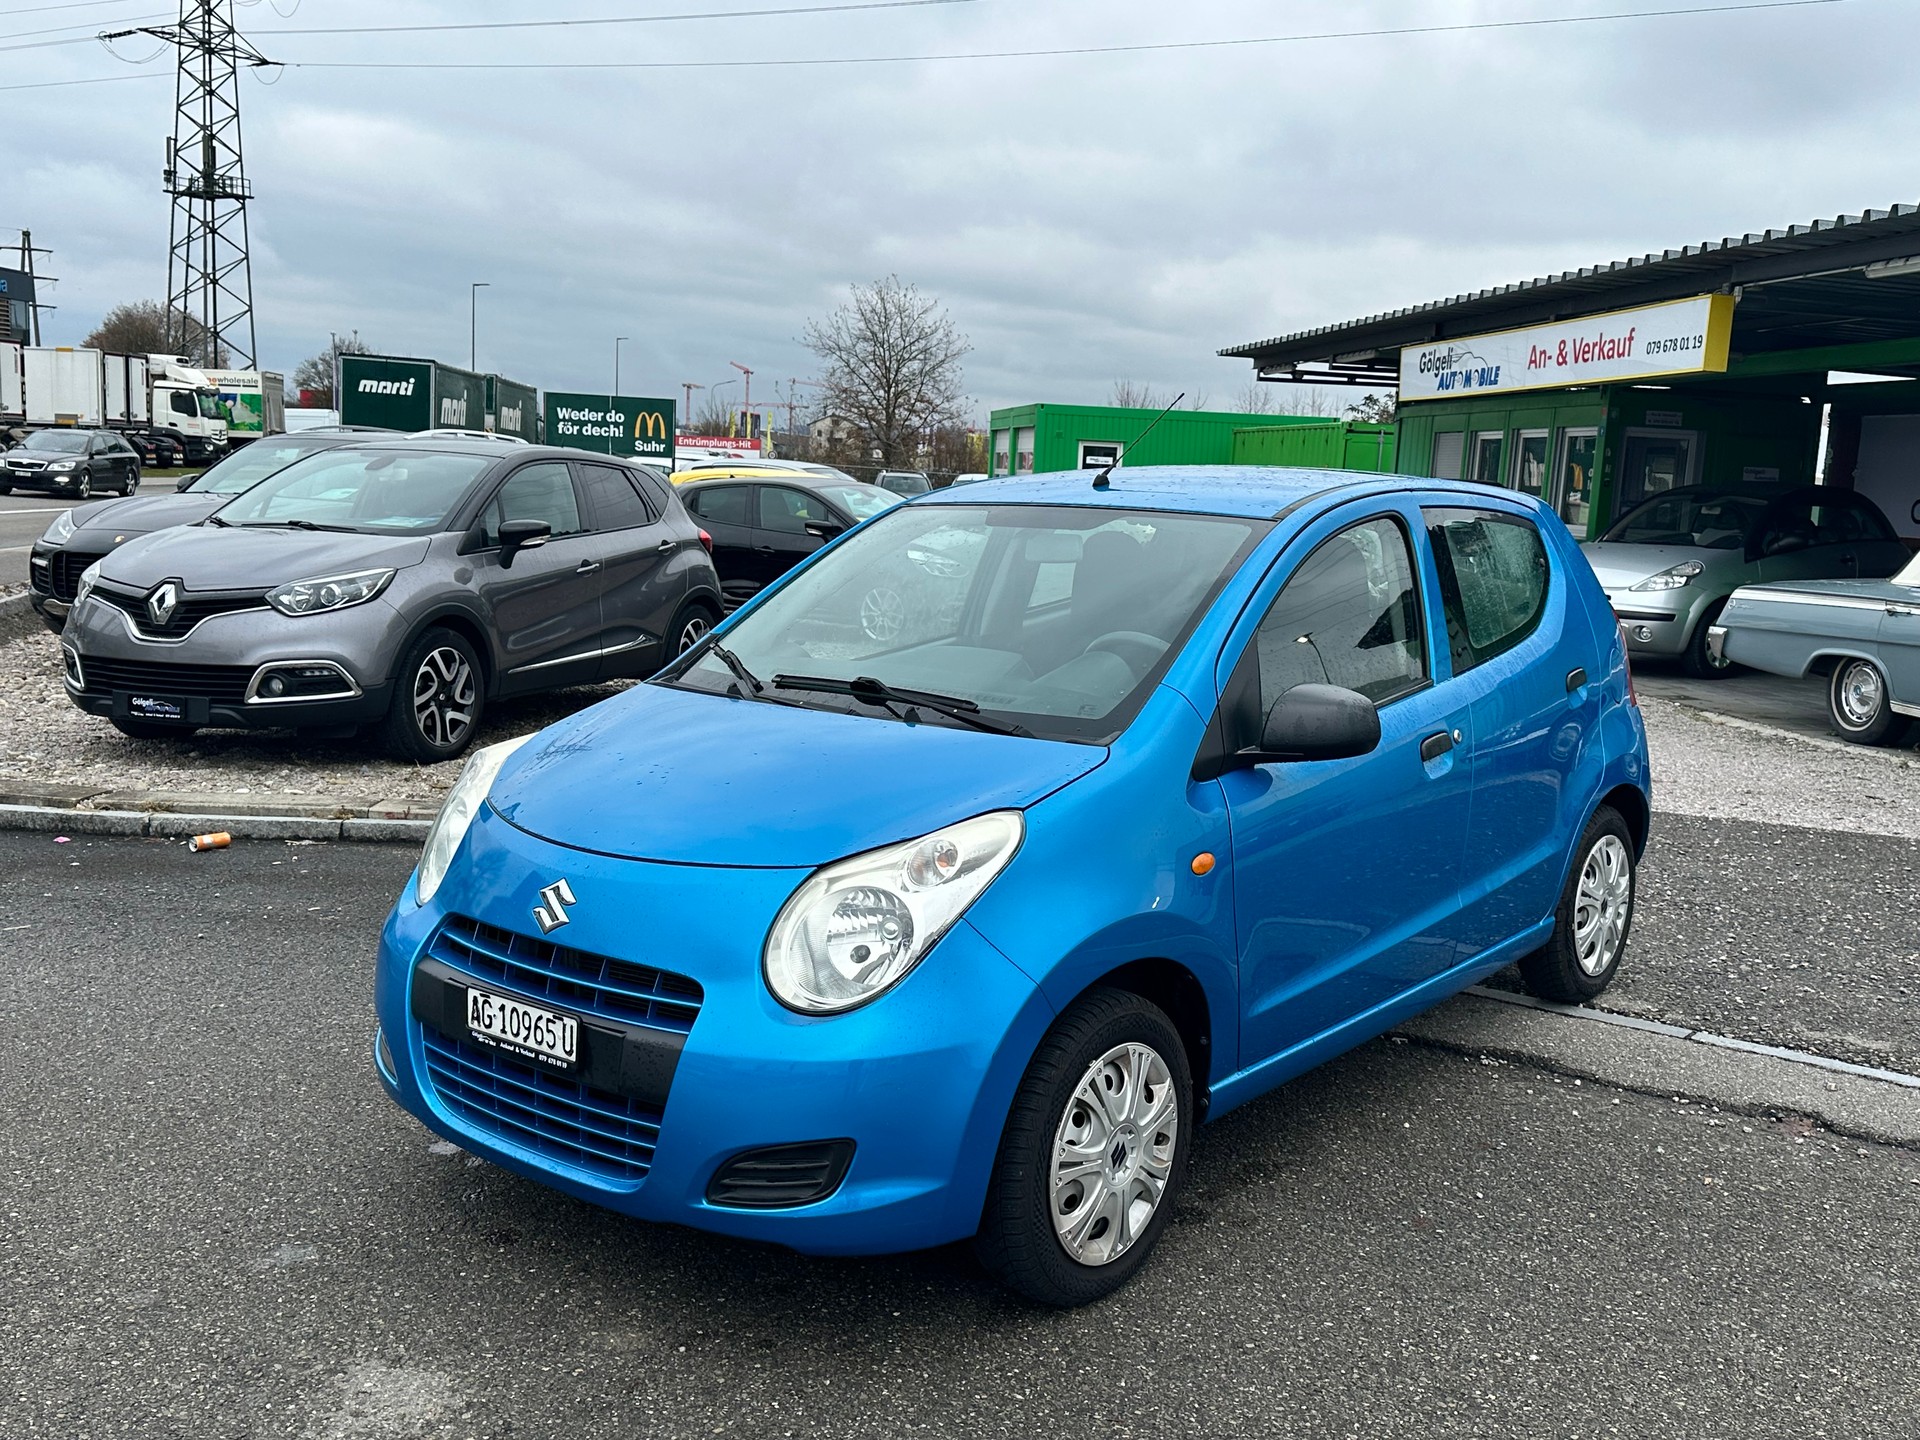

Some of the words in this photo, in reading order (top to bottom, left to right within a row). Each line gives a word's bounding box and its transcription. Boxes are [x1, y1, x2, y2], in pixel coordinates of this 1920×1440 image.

[1527, 344, 1553, 370] An-
[1556, 339, 1568, 367] &
[1572, 327, 1636, 364] Verkauf
[1646, 341, 1661, 355] 079
[1662, 338, 1678, 353] 678
[1679, 336, 1690, 351] 01
[1692, 334, 1703, 349] 19
[1420, 347, 1453, 378] Gölgeli
[358, 377, 416, 396] marti
[440, 389, 467, 427] marti
[501, 399, 522, 432] marti
[556, 407, 604, 422] Weder
[606, 409, 625, 423] do
[557, 422, 579, 434] för
[582, 423, 624, 438] dech!
[634, 440, 666, 452] Suhr
[678, 436, 752, 449] Entrümplungs-Hit
